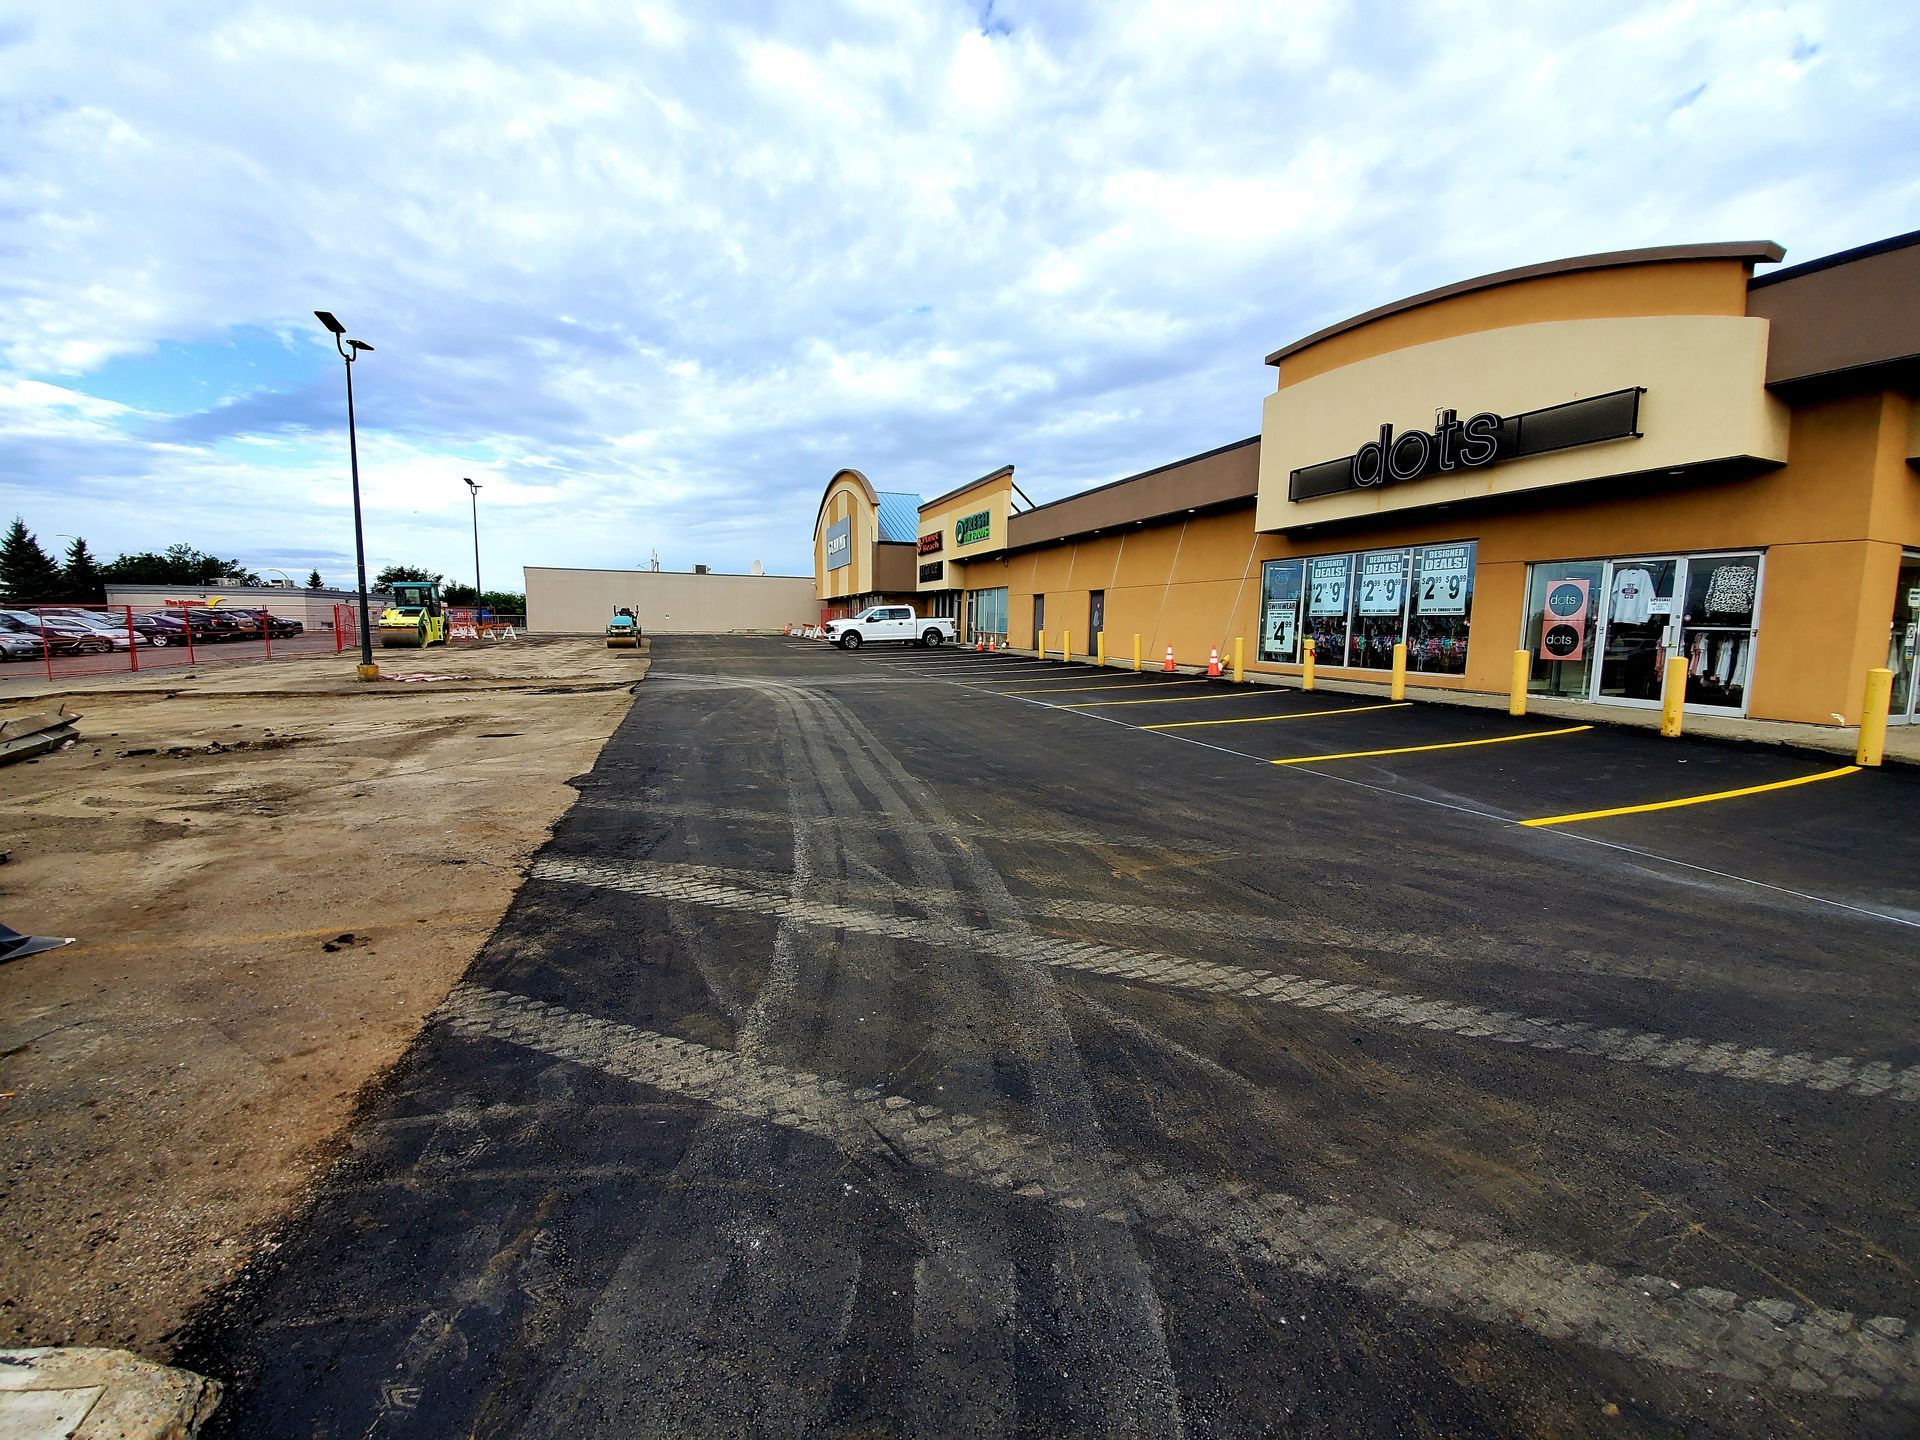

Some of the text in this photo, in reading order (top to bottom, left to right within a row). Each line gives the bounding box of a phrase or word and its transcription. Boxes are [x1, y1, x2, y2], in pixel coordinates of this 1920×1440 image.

[1353, 408, 1502, 488] dots
[964, 511, 990, 532] FRESH
[922, 541, 939, 552] Beach
[1369, 555, 1399, 563] DESIGNER
[1429, 549, 1464, 558] DESIGNER
[1366, 563, 1401, 575] DEALS!
[1425, 557, 1467, 570] DEALS!
[1315, 567, 1345, 578] DEALS!
[1550, 595, 1576, 605] dots
[1546, 635, 1572, 645] dots
